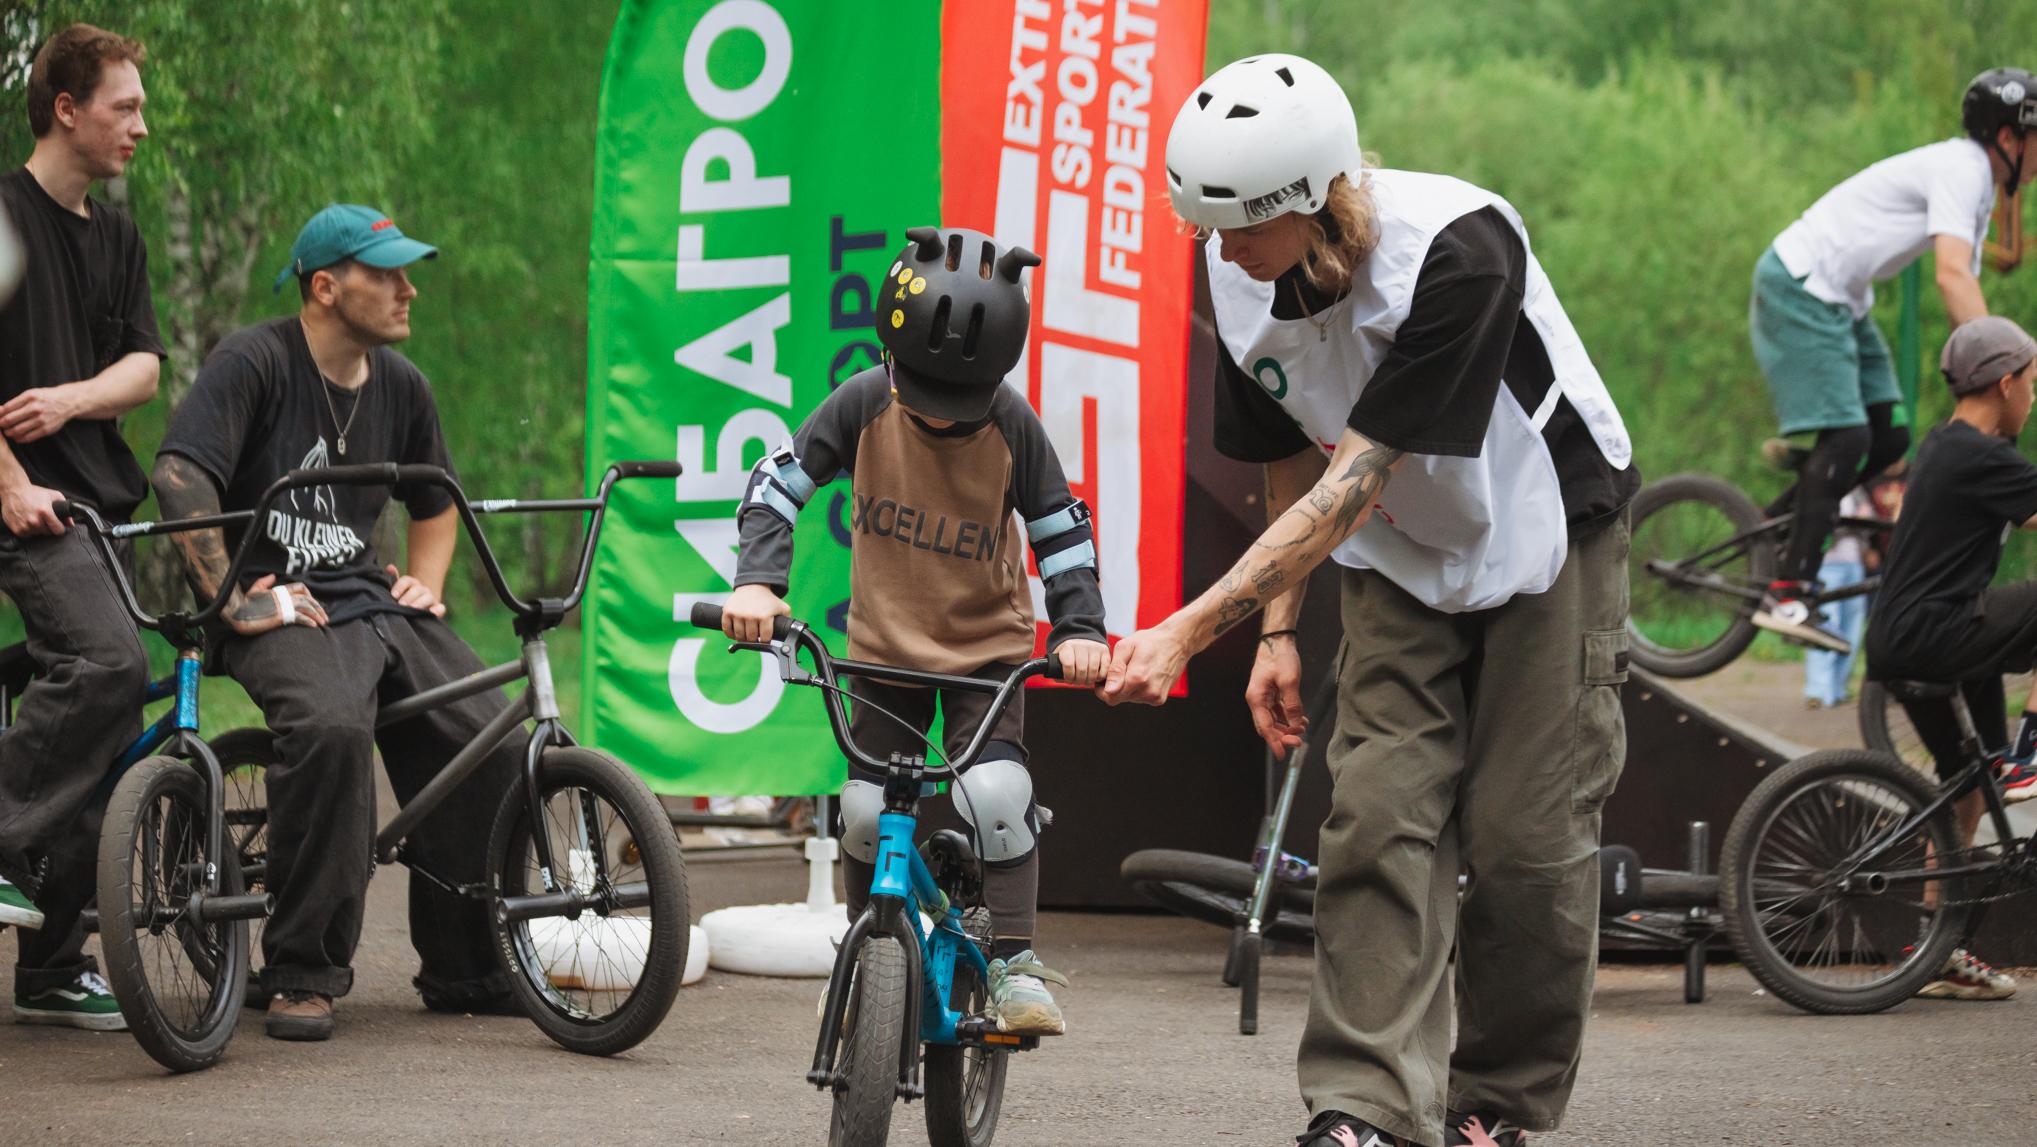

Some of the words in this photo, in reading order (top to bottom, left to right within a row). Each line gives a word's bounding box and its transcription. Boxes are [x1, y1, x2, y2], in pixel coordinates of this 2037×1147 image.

[1099, 0, 1160, 289] FEDERAT
[267, 509, 291, 545] DU
[853, 491, 1000, 562] XCELLEN
